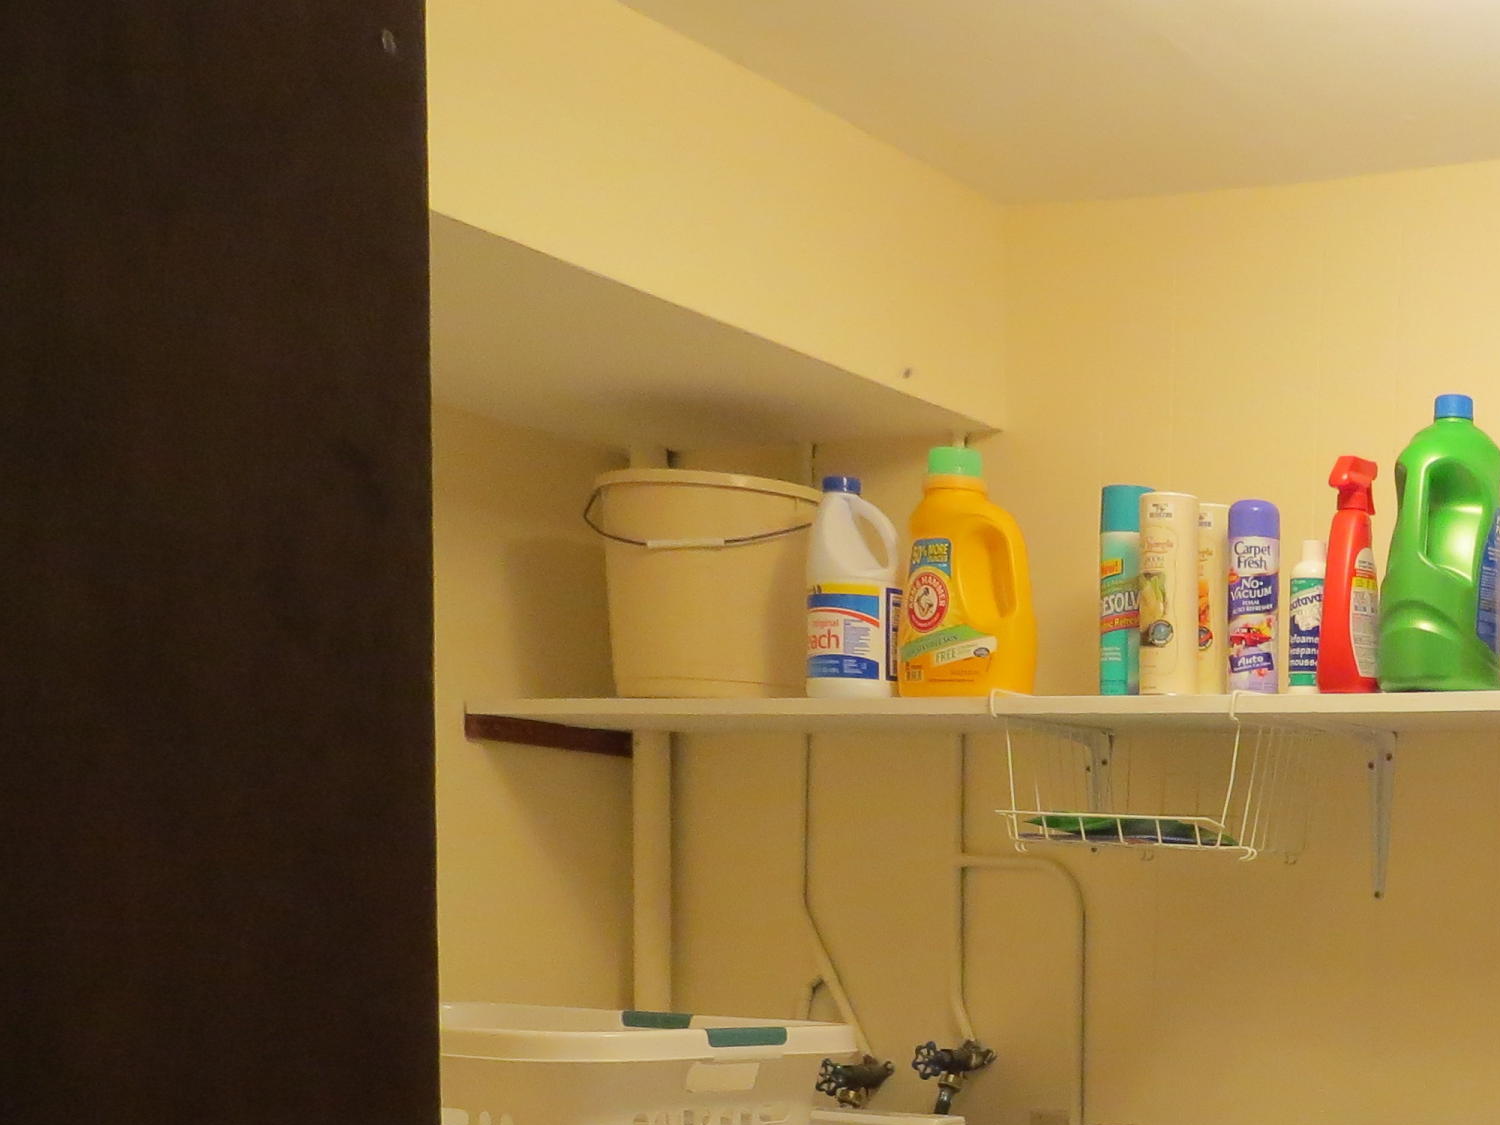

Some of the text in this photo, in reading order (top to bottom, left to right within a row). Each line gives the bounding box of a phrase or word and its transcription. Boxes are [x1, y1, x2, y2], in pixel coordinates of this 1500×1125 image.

[1234, 541, 1271, 558] Carpet
[1237, 555, 1267, 571] Fresh
[1230, 586, 1273, 600] VACUUM
[1101, 590, 1140, 617] ESOLV
[808, 628, 840, 649] ach
[935, 647, 957, 663] FREE
[1238, 655, 1264, 667] Auto
